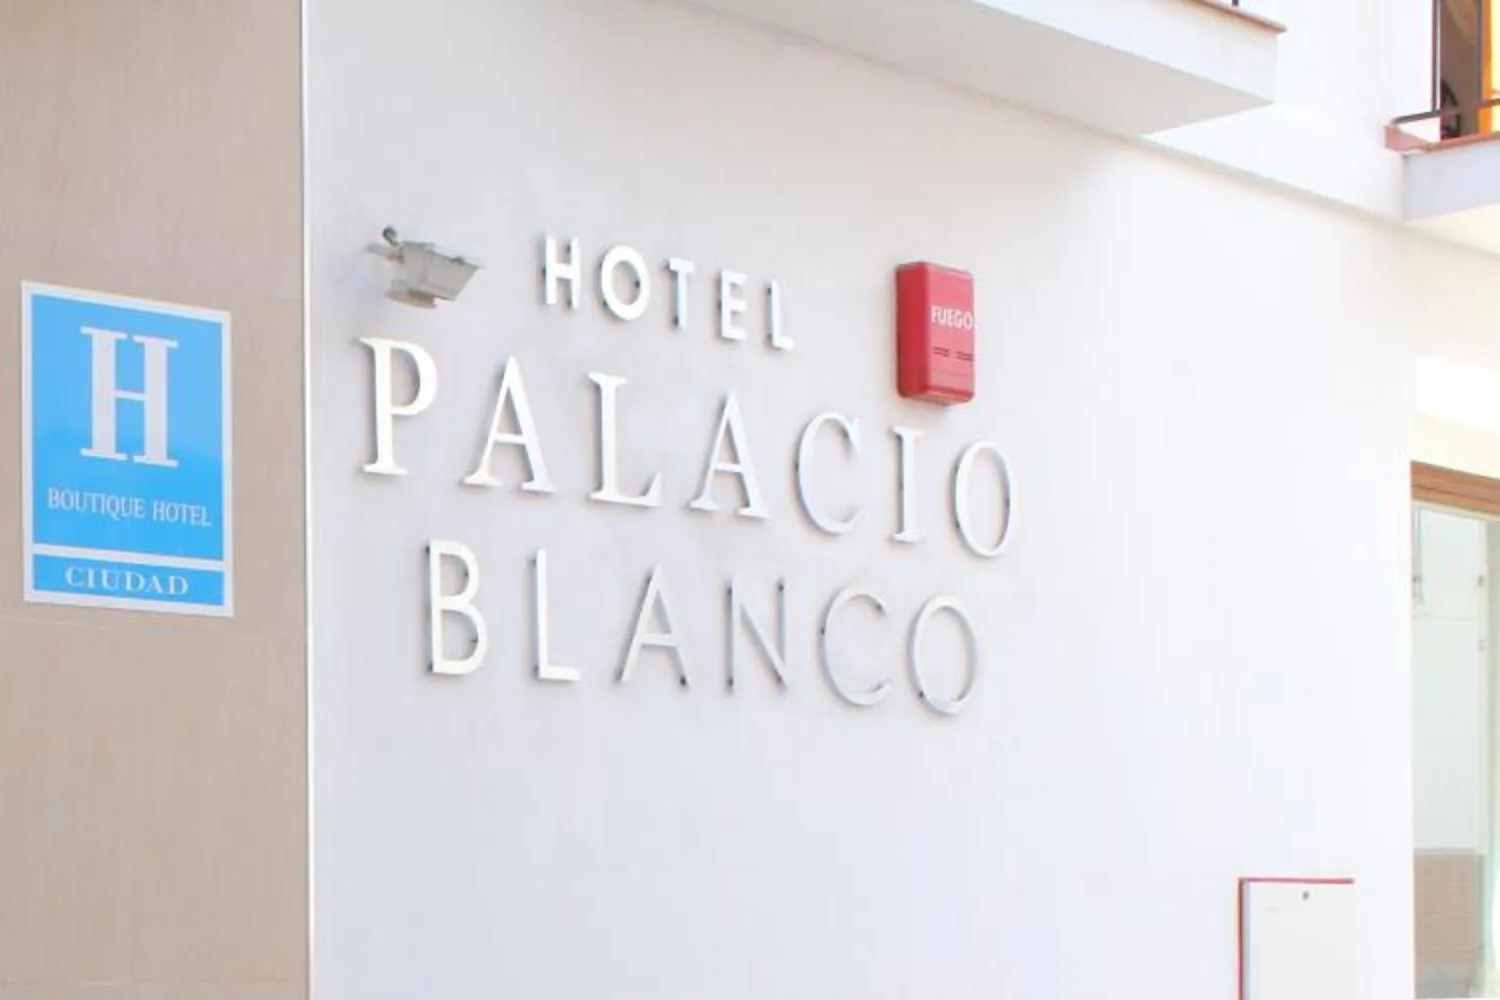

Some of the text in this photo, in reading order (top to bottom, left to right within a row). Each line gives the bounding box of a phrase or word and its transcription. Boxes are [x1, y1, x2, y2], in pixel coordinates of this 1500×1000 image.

[542, 235, 794, 351] HOTEL
[931, 305, 973, 331] FUEGO
[80, 326, 178, 468] H
[359, 336, 1016, 558] PALACIO
[47, 487, 211, 527] BOUTIQUE HOTEL
[64, 564, 190, 596] CIUDAD
[426, 538, 979, 716] BLANCO
